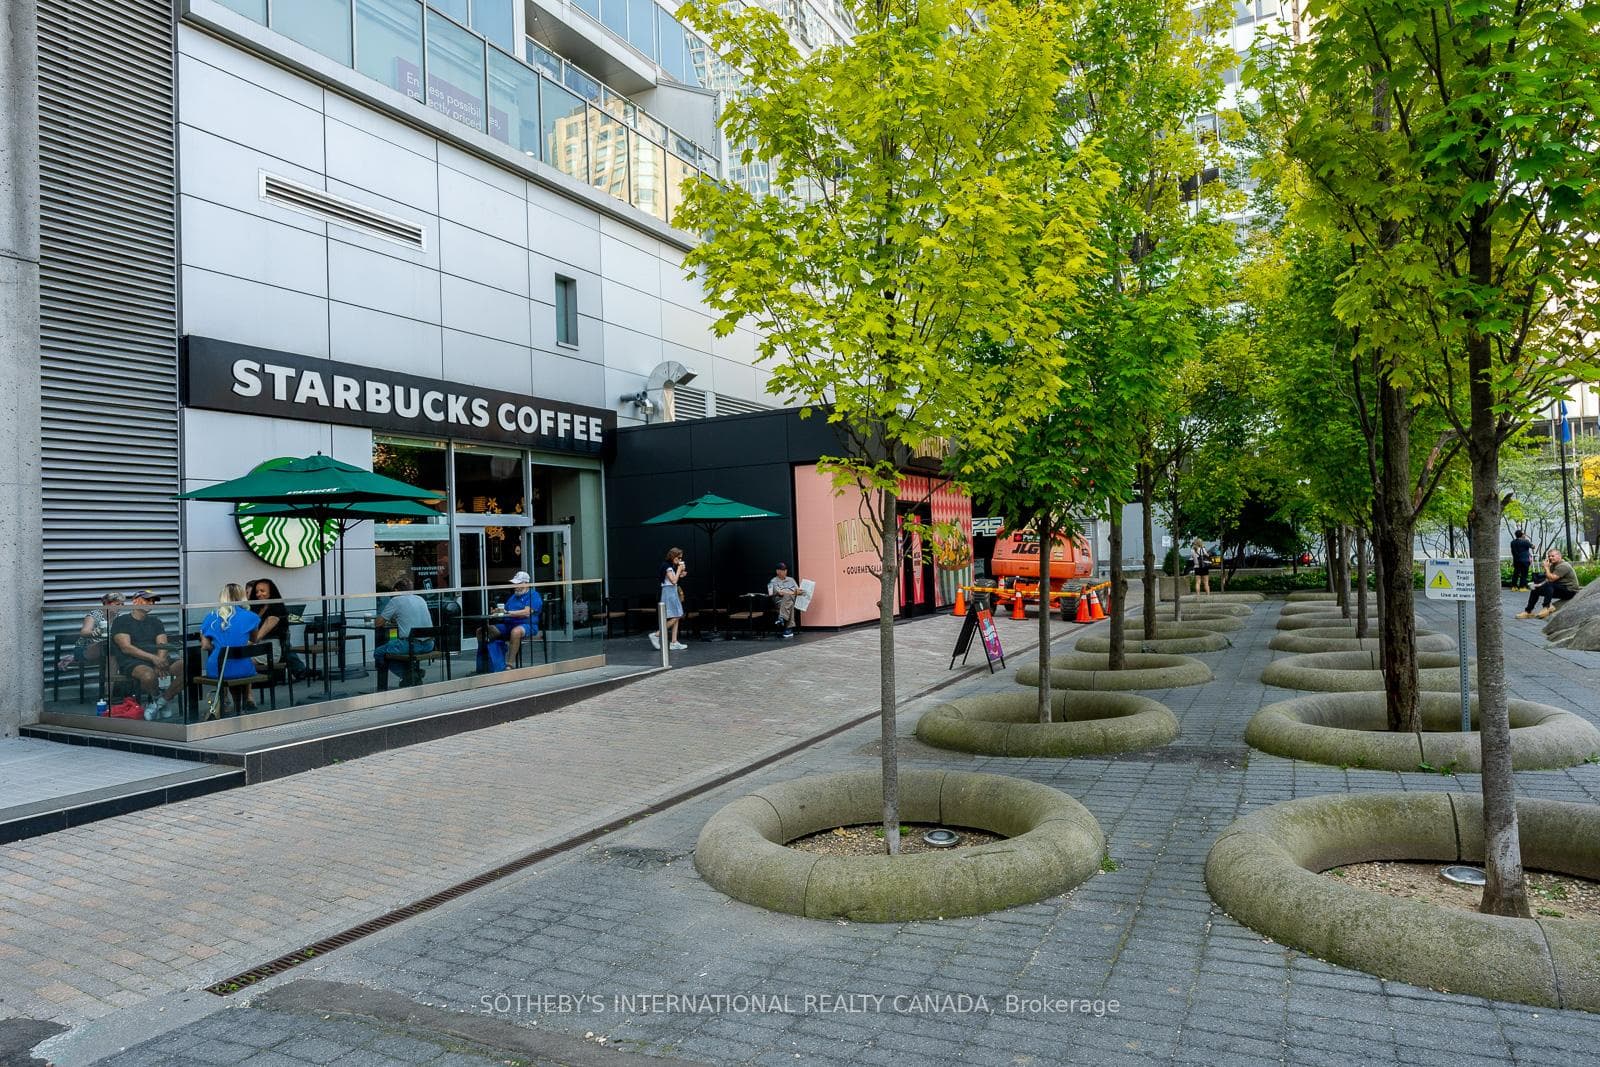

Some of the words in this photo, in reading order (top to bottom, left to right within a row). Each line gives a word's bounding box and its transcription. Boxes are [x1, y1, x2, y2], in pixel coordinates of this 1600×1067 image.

[406, 71, 445, 100] Eness
[232, 359, 490, 428] STARBUCKS
[497, 402, 603, 443] COFFEE
